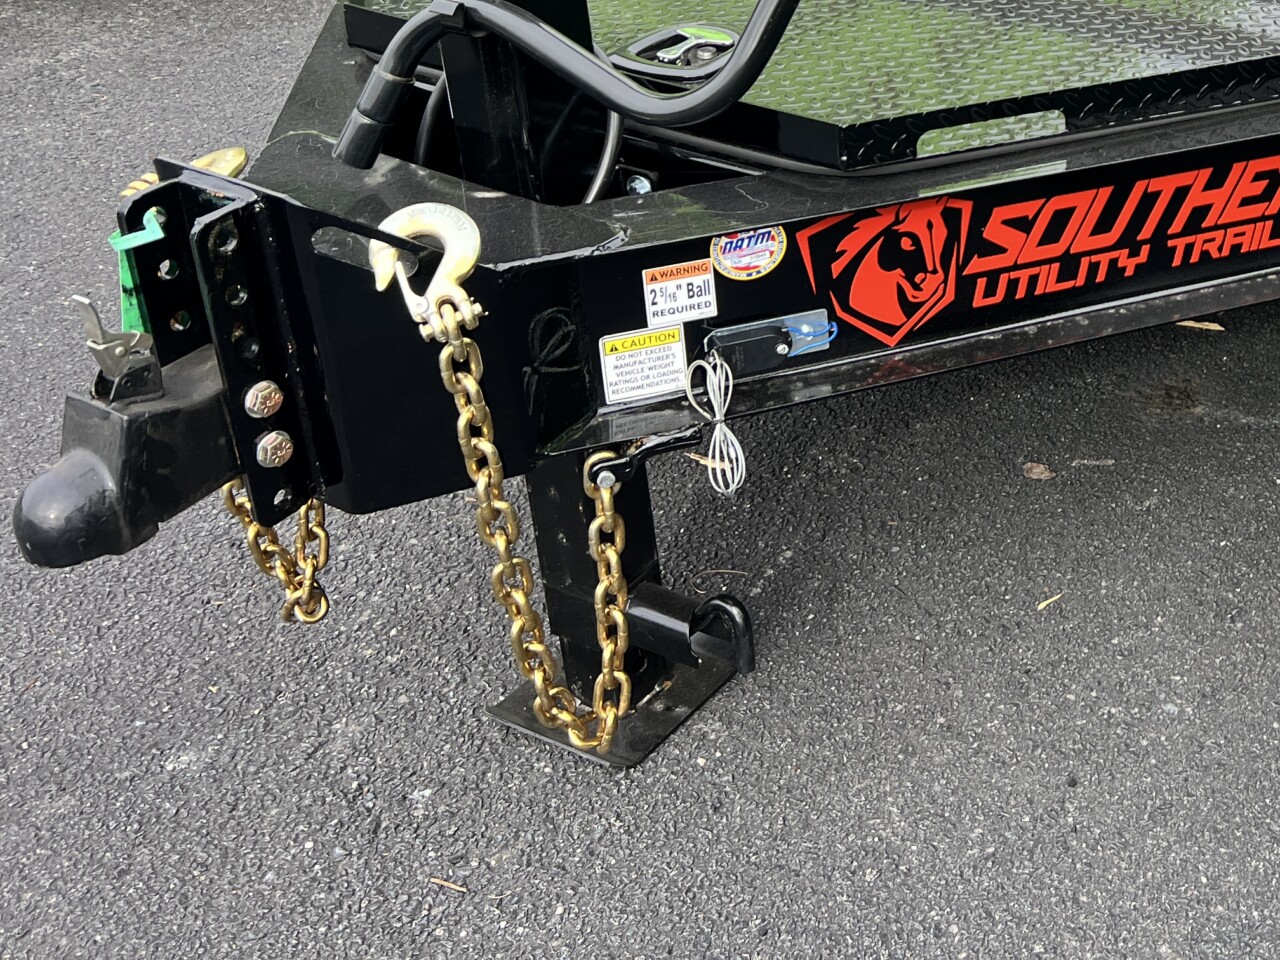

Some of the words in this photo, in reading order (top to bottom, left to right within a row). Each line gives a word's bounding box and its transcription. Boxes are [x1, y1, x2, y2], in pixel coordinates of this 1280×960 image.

[722, 230, 772, 255] NATM
[659, 263, 708, 279] WARNING
[972, 244, 1150, 308] UTILITY
[650, 289, 658, 306] 2
[687, 278, 711, 299] Ball
[652, 300, 712, 318] REQUIRED
[621, 331, 676, 349] CAUTION
[628, 351, 643, 359] NOT
[645, 345, 672, 356] EXCEED
[613, 353, 676, 370] MANUFACTURER'S
[616, 367, 645, 378] VEHICLE
[647, 361, 675, 372] WEIGHT
[609, 377, 639, 387] RATINGS
[652, 367, 684, 379] LOADING
